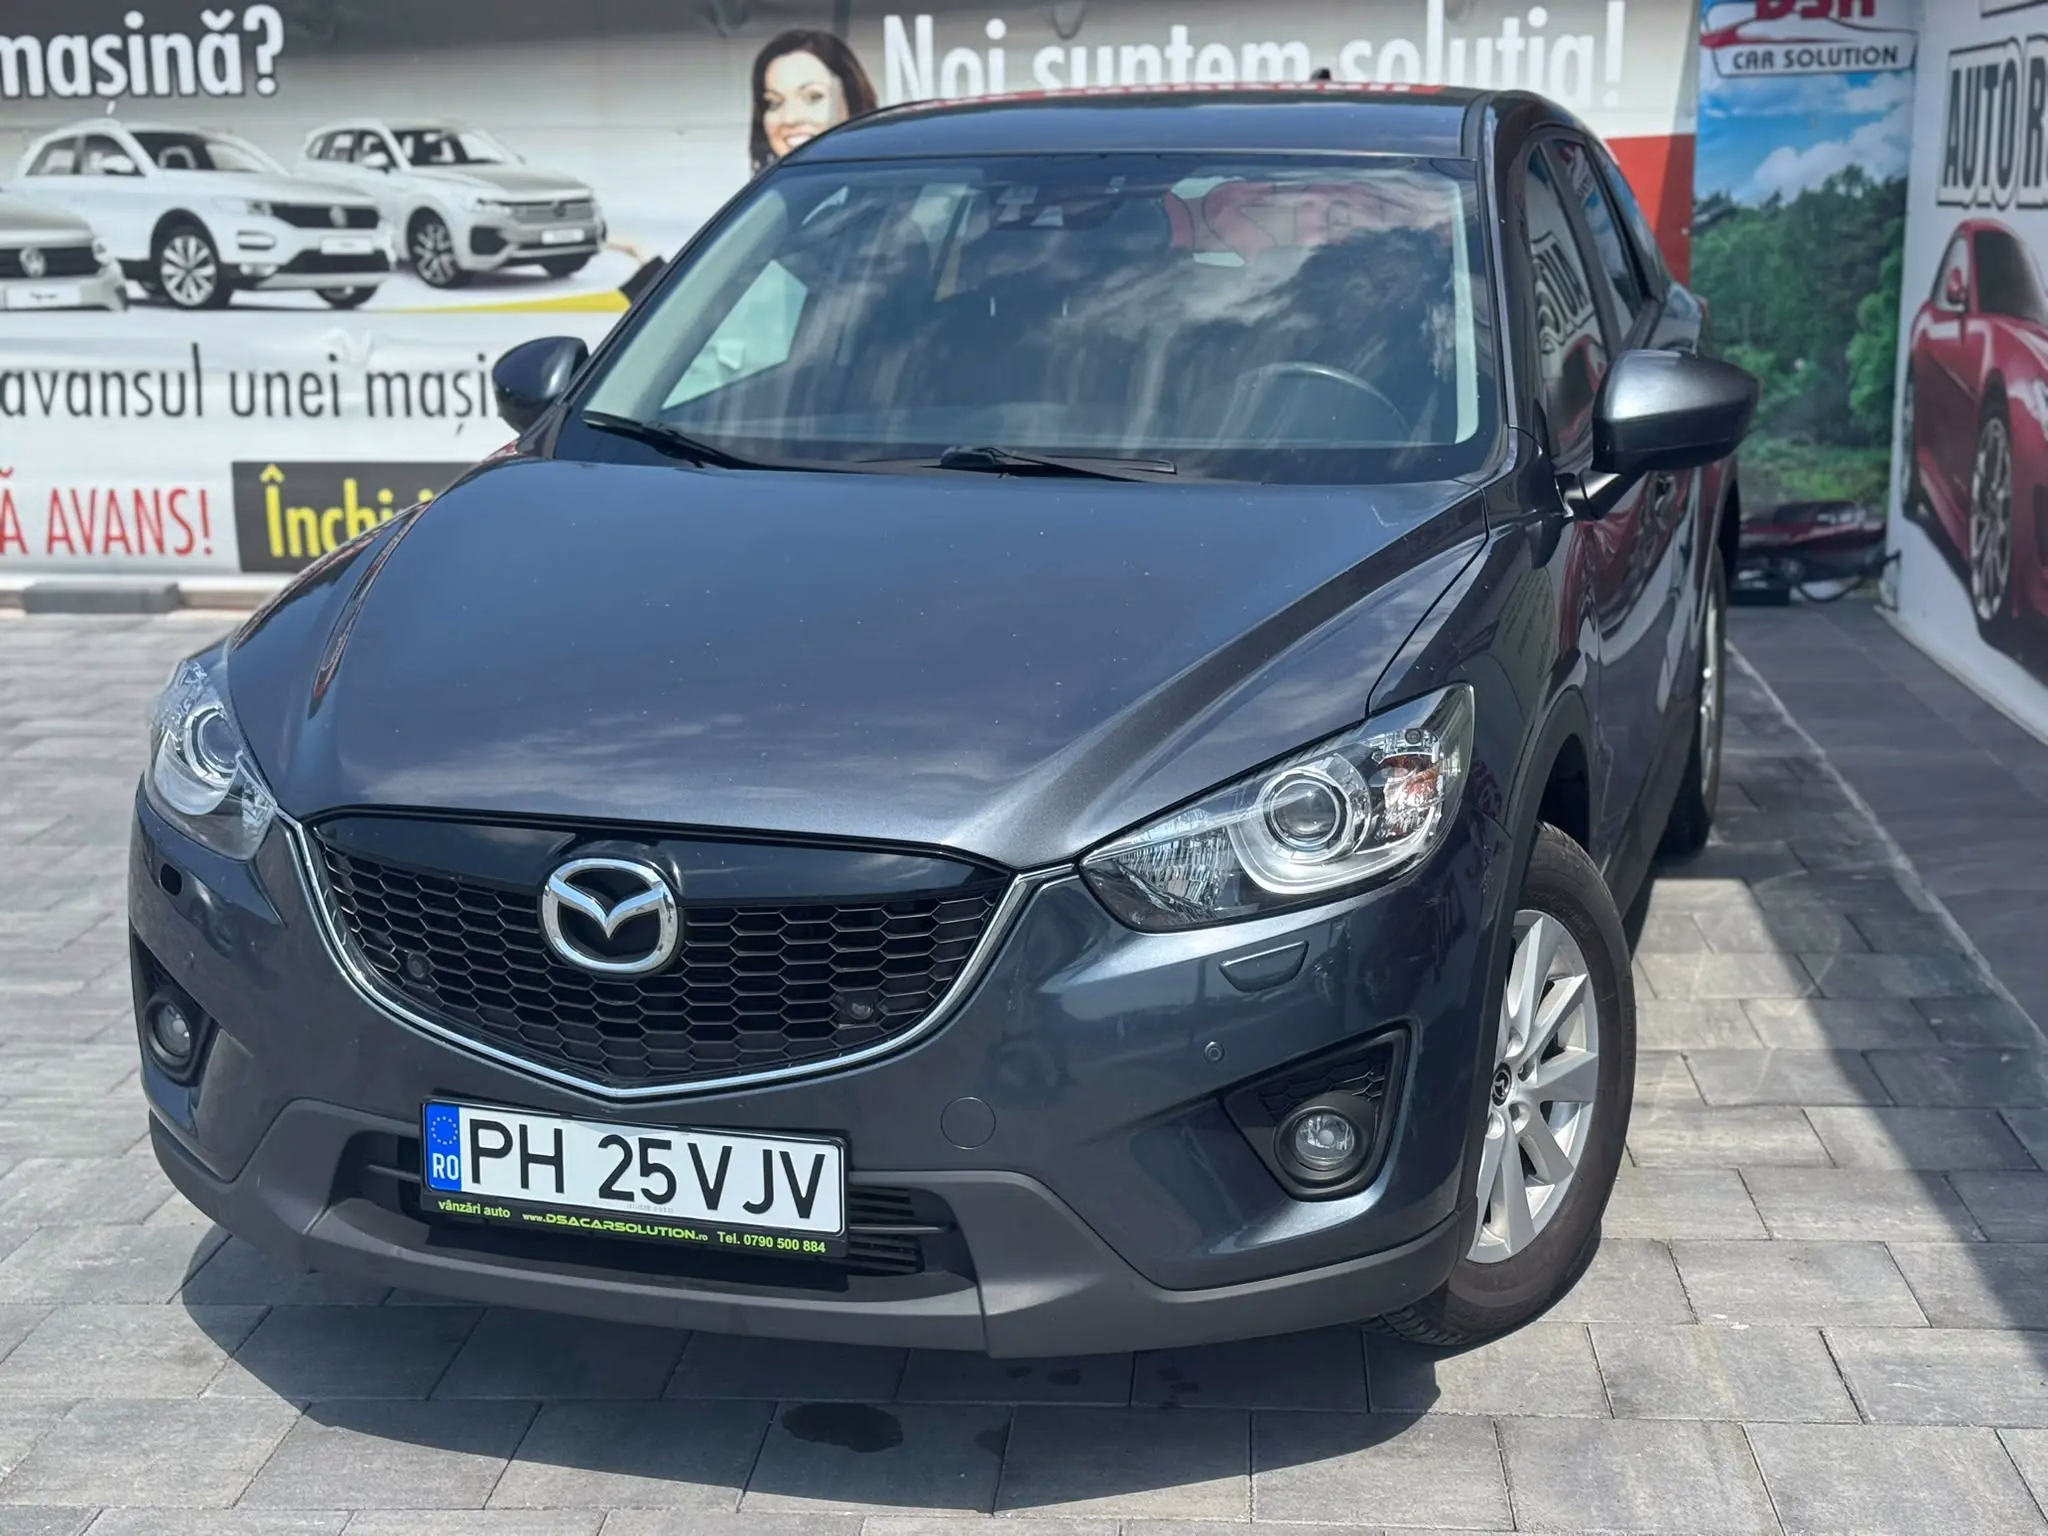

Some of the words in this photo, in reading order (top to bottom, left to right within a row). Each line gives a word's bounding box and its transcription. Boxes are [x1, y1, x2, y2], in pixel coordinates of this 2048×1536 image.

[883, 13, 1008, 106] Noi
[1732, 51, 1775, 70] CAR
[1783, 45, 1899, 69] SOLUTION
[0, 342, 204, 418] avansul
[229, 353, 342, 418] unei
[366, 352, 504, 436] mași
[46, 488, 213, 557] AVANS!
[432, 1152, 460, 1181] RO
[468, 1118, 565, 1194] PH
[437, 1199, 482, 1215] vânzări
[483, 1206, 512, 1219] auto
[717, 1231, 741, 1246] Tel.
[743, 1234, 774, 1249] 0790
[776, 1238, 800, 1251] 500
[802, 1241, 827, 1254] 884
